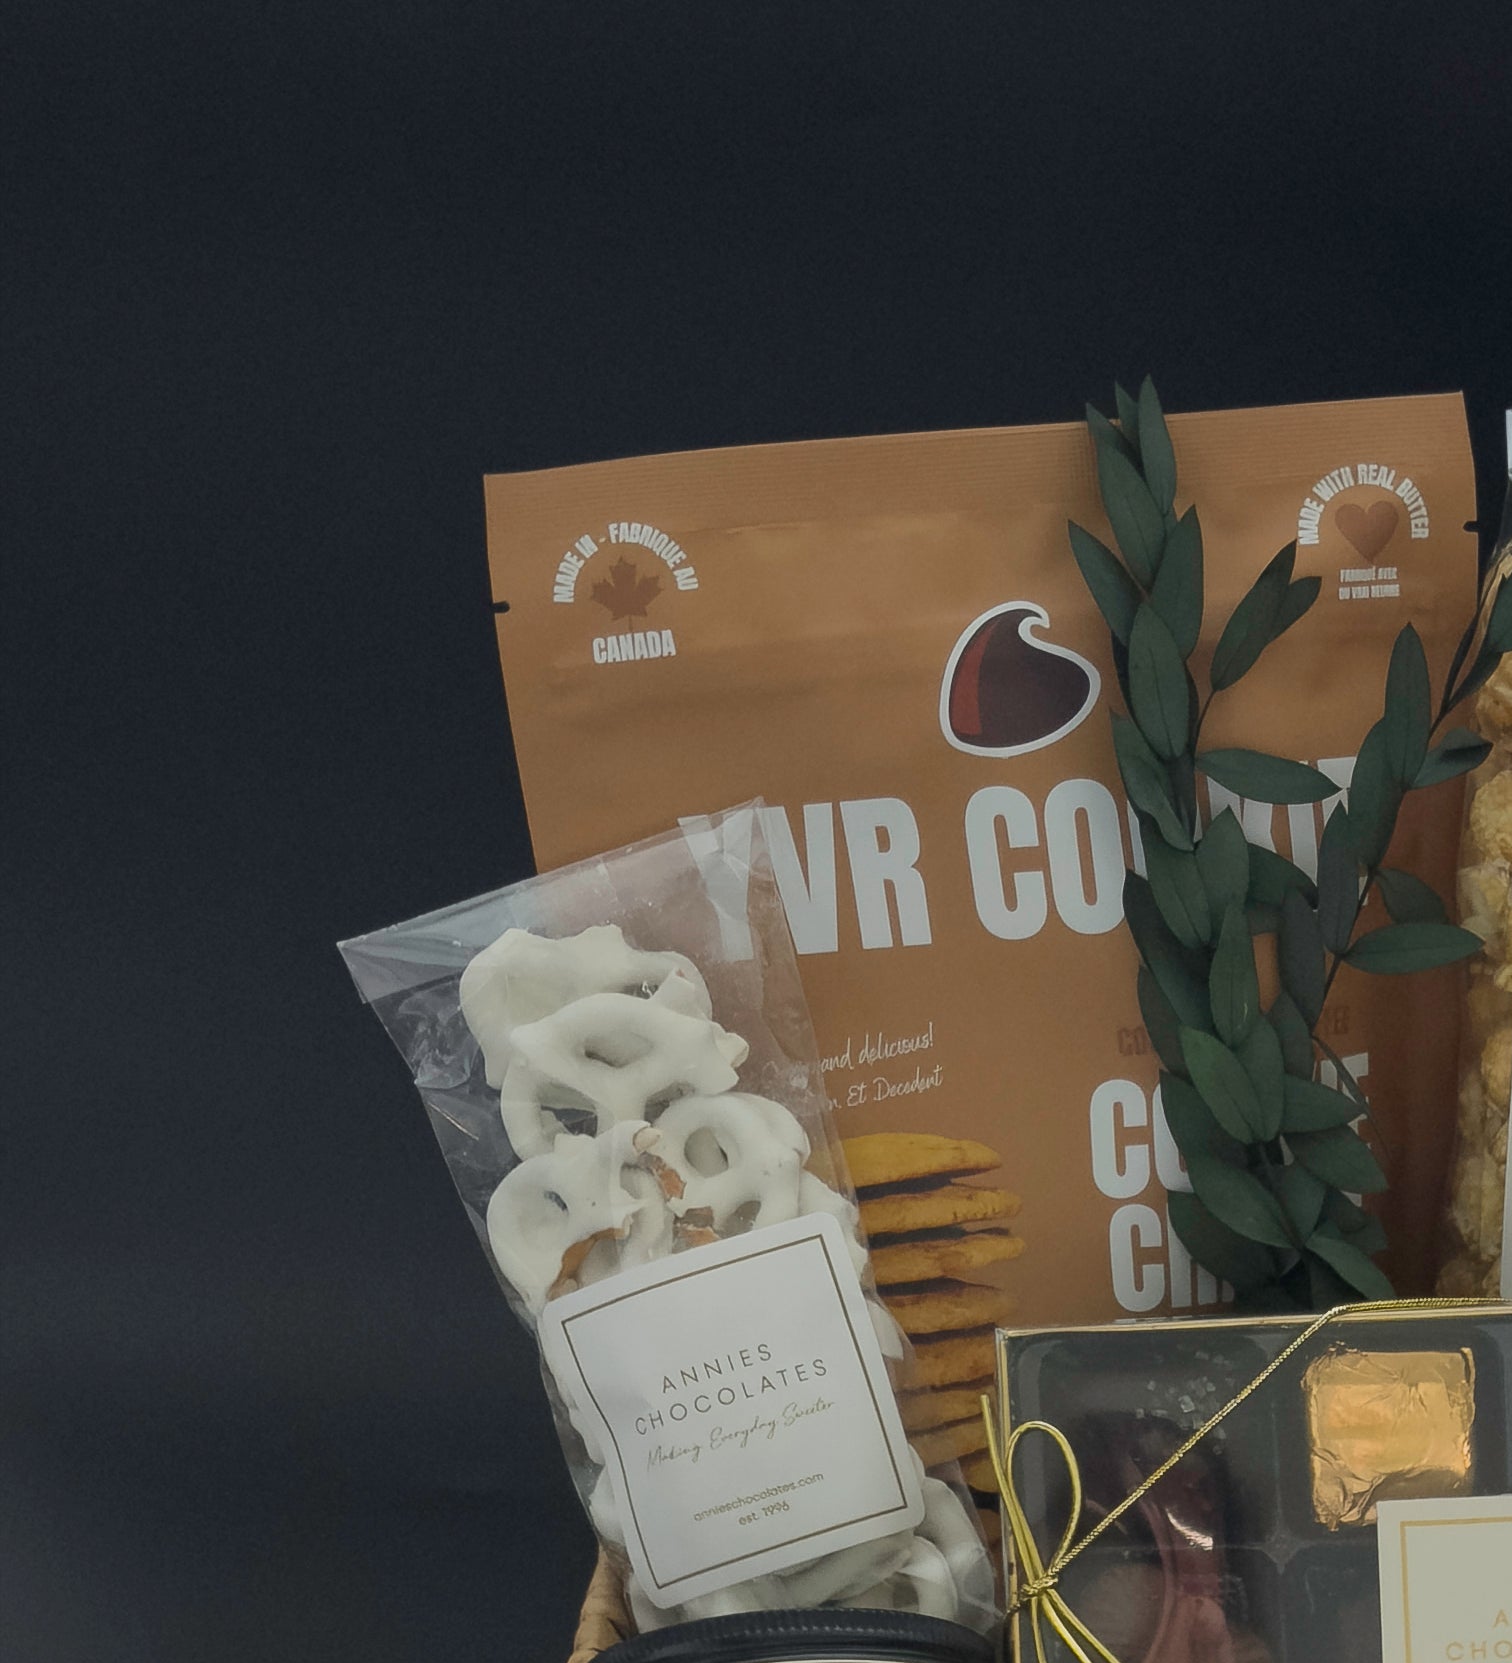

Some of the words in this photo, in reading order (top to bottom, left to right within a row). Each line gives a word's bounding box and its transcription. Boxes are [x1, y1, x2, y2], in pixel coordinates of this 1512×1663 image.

[1298, 497, 1325, 545] MADE
[1312, 466, 1355, 502] WITH
[1357, 464, 1395, 491] REAL
[1395, 478, 1430, 539] BUTTER
[553, 551, 585, 603] MADE
[575, 534, 599, 558] IN
[608, 522, 687, 569] FABRIQUE
[673, 566, 699, 590] AU
[593, 629, 677, 664] CANADA
[821, 1037, 854, 1072] and
[859, 1022, 934, 1066] delicious!
[847, 1084, 867, 1107] Et
[662, 1343, 772, 1394] ANNIES
[635, 1359, 827, 1435] CHOCOLATES
[647, 1444, 701, 1472] Making
[709, 1416, 777, 1450] Everyday
[782, 1397, 835, 1428] Sweeter
[762, 1500, 790, 1518] 1996
